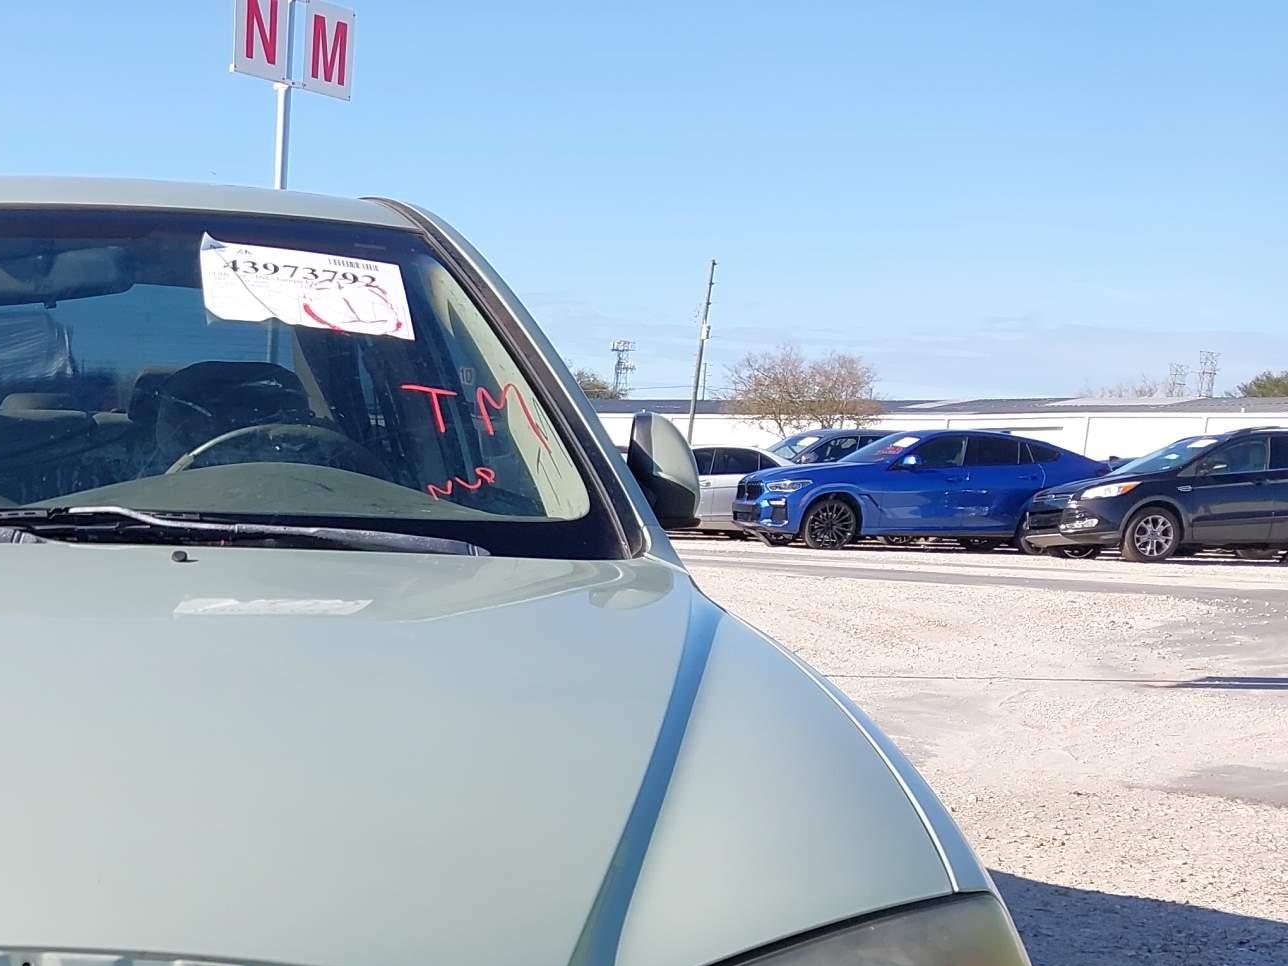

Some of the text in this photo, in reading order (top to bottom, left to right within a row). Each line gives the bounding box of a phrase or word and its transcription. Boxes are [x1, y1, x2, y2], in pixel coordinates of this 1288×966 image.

[245, 0, 278, 65] N
[311, 14, 348, 86] M
[224, 259, 379, 288] 43973792
